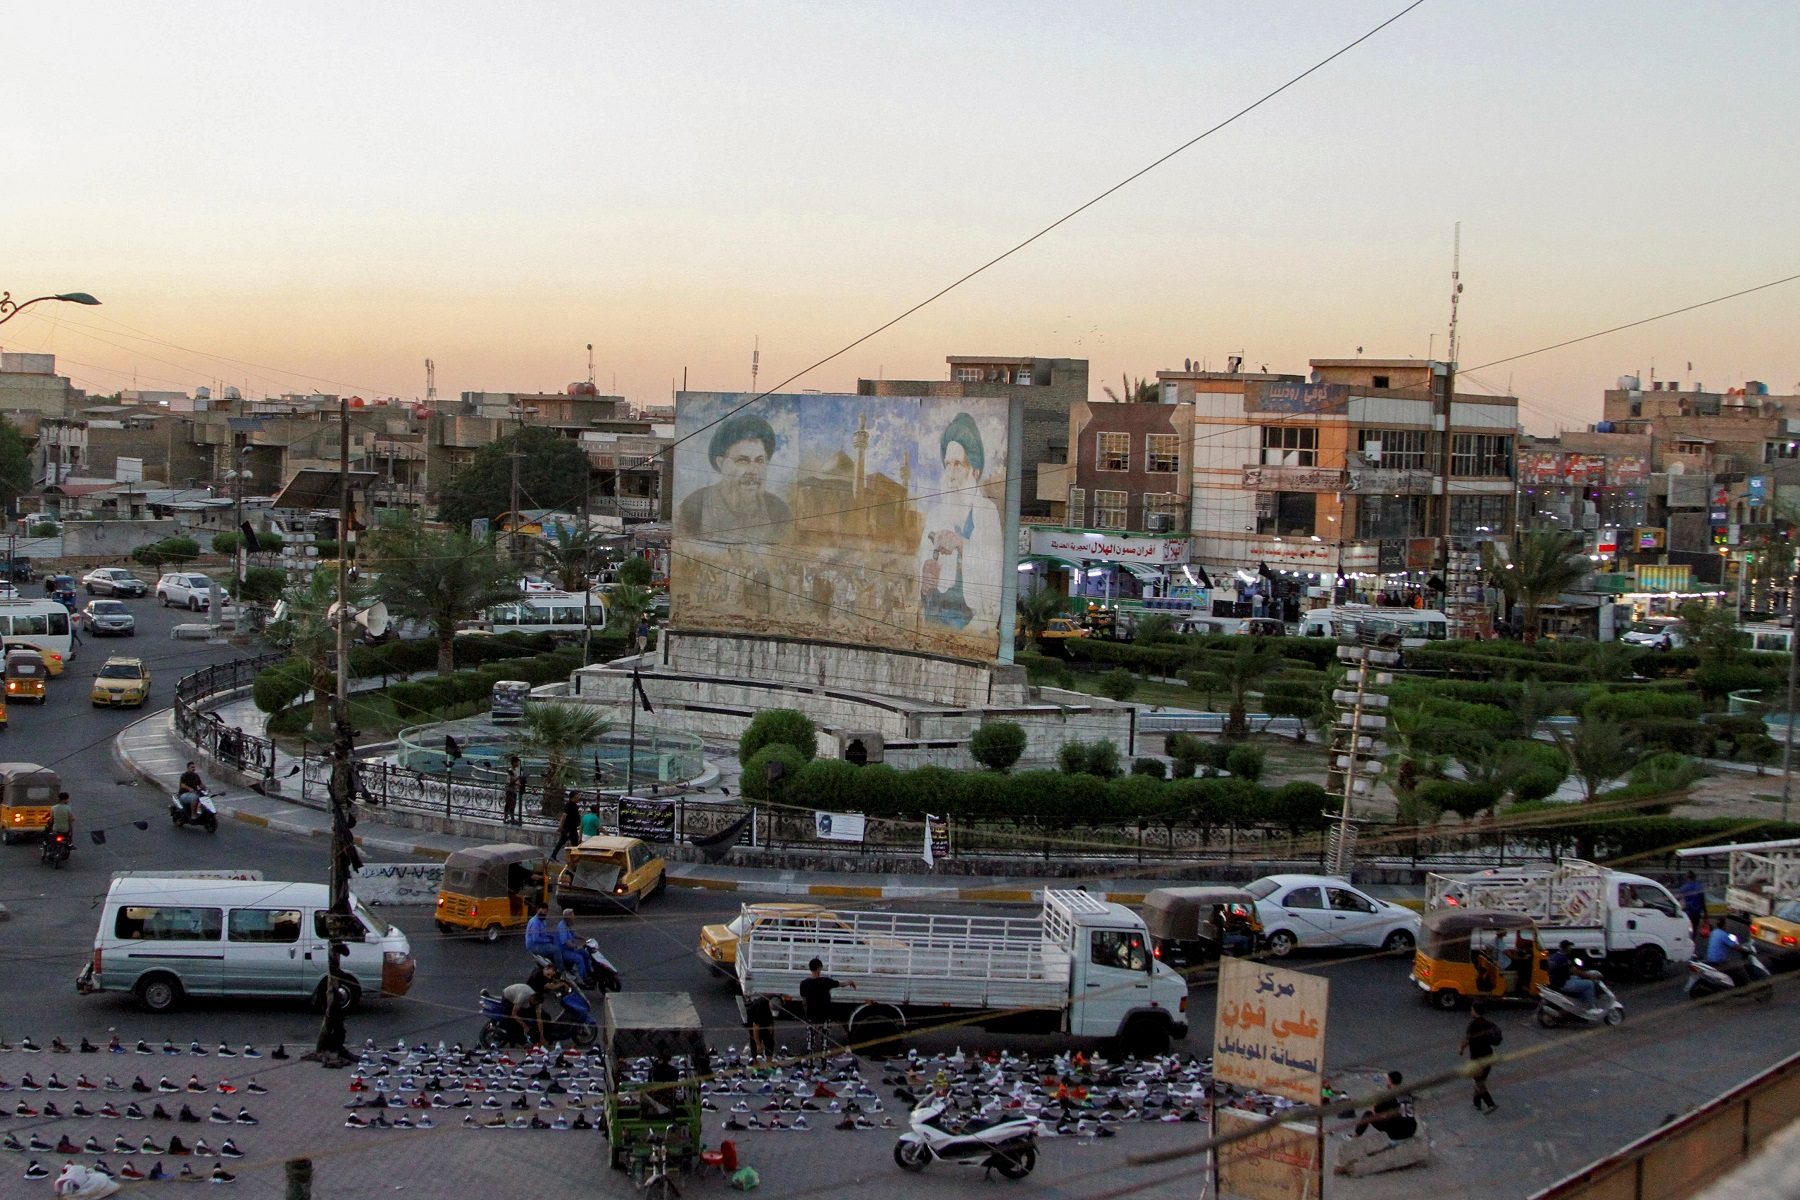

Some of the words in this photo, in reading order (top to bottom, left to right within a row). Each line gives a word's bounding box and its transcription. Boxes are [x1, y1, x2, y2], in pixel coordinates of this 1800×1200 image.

[1091, 541, 1115, 556] الهلال
[1255, 972, 1296, 998] مركز
[1222, 999, 1266, 1030] فون
[1271, 1008, 1319, 1045] علي
[1218, 1035, 1266, 1060] الموبايل
[1270, 1045, 1318, 1073] لصيانة
